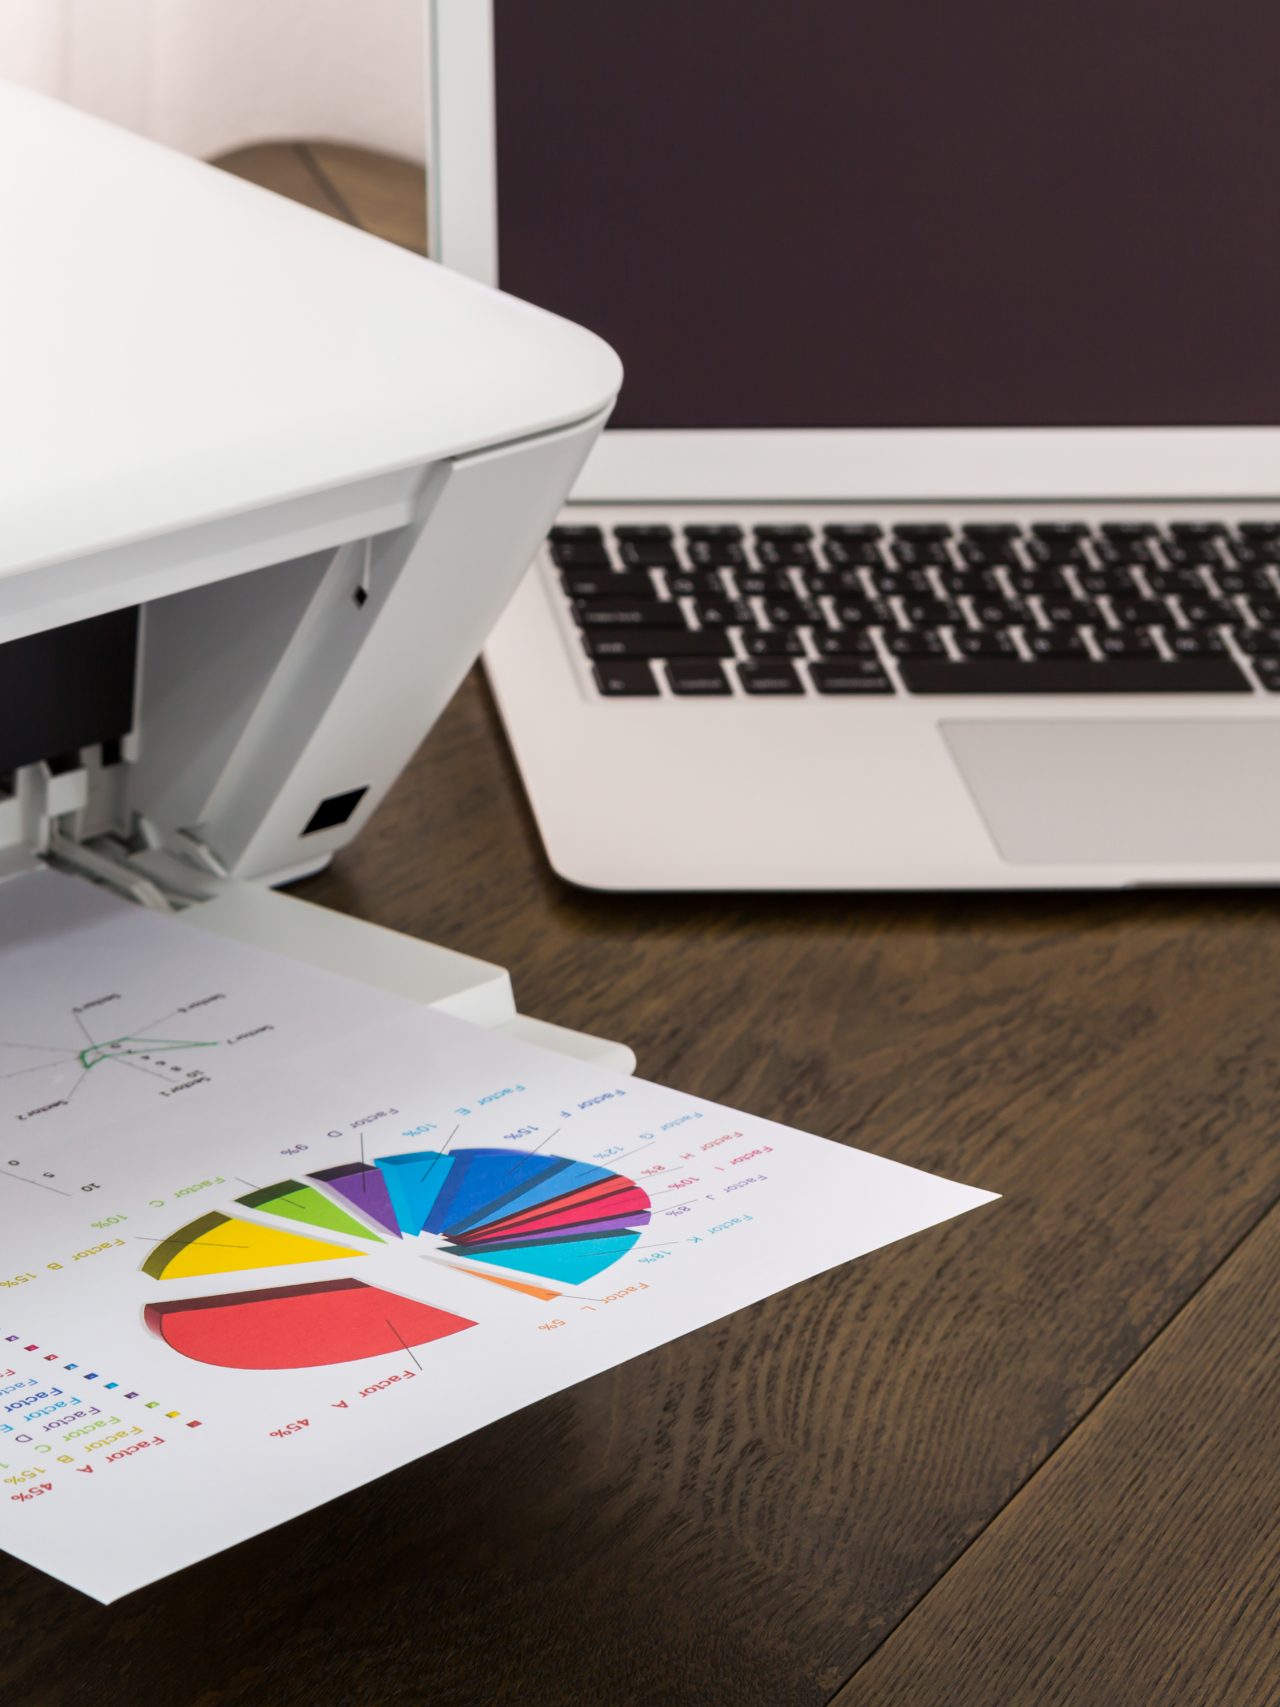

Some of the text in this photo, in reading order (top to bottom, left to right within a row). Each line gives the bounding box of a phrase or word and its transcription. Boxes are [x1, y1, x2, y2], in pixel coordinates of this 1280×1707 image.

[280, 1108, 399, 1155] Factor D 9%
[7, 1159, 21, 1167] 0
[42, 1171, 56, 1179] 5
[81, 1183, 100, 1192] 10
[90, 1176, 226, 1228] Factor C 10%
[638, 1215, 753, 1264] Factor K 18%
[0, 1239, 125, 1288] Factor B 15%
[595, 1283, 649, 1304] Factor
[538, 1319, 566, 1331] 5%
[4, 1387, 63, 1412] Factor
[24, 1397, 82, 1421] Factor
[269, 1370, 416, 1438] Factor A 45%
[43, 1407, 101, 1431] Factor
[62, 1416, 121, 1442] Factor
[14, 1433, 34, 1444] D
[33, 1444, 53, 1454] C
[4, 1426, 143, 1485] Factor B 15%
[11, 1436, 165, 1502] Factor A 45%
